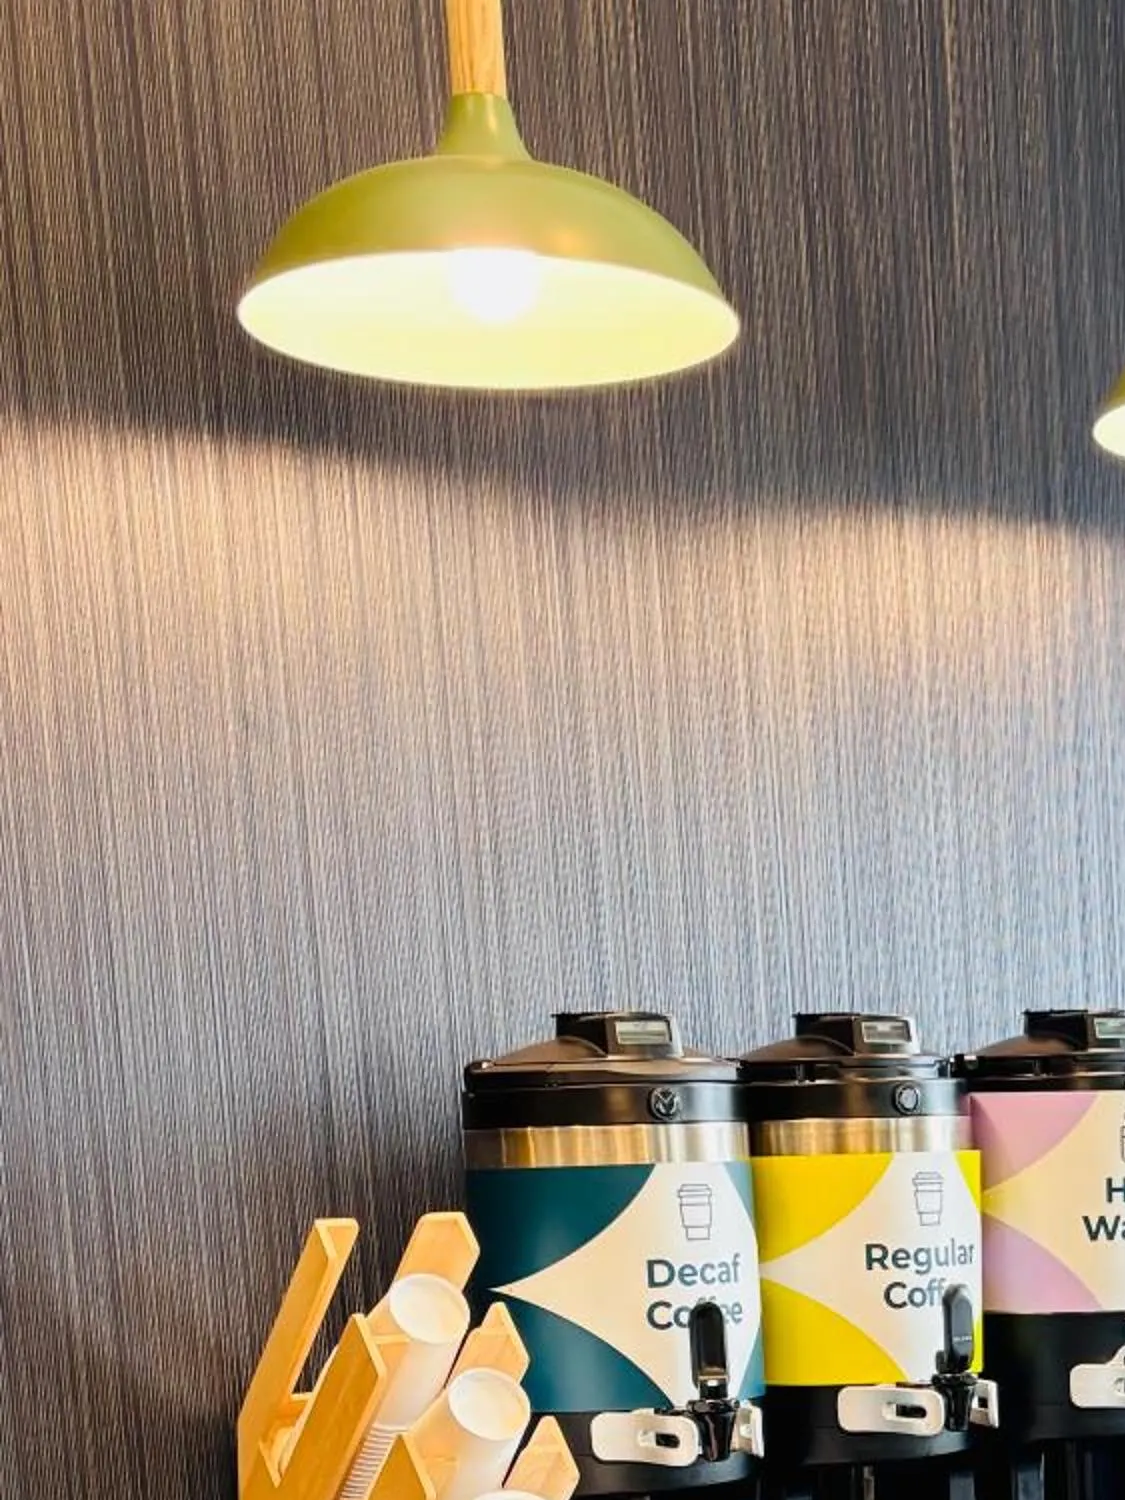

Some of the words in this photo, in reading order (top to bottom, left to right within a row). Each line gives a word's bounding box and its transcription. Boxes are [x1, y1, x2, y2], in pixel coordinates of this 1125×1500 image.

[646, 1252, 741, 1289] Decaf
[865, 1237, 975, 1275] Regular
[884, 1277, 950, 1309] Coff
